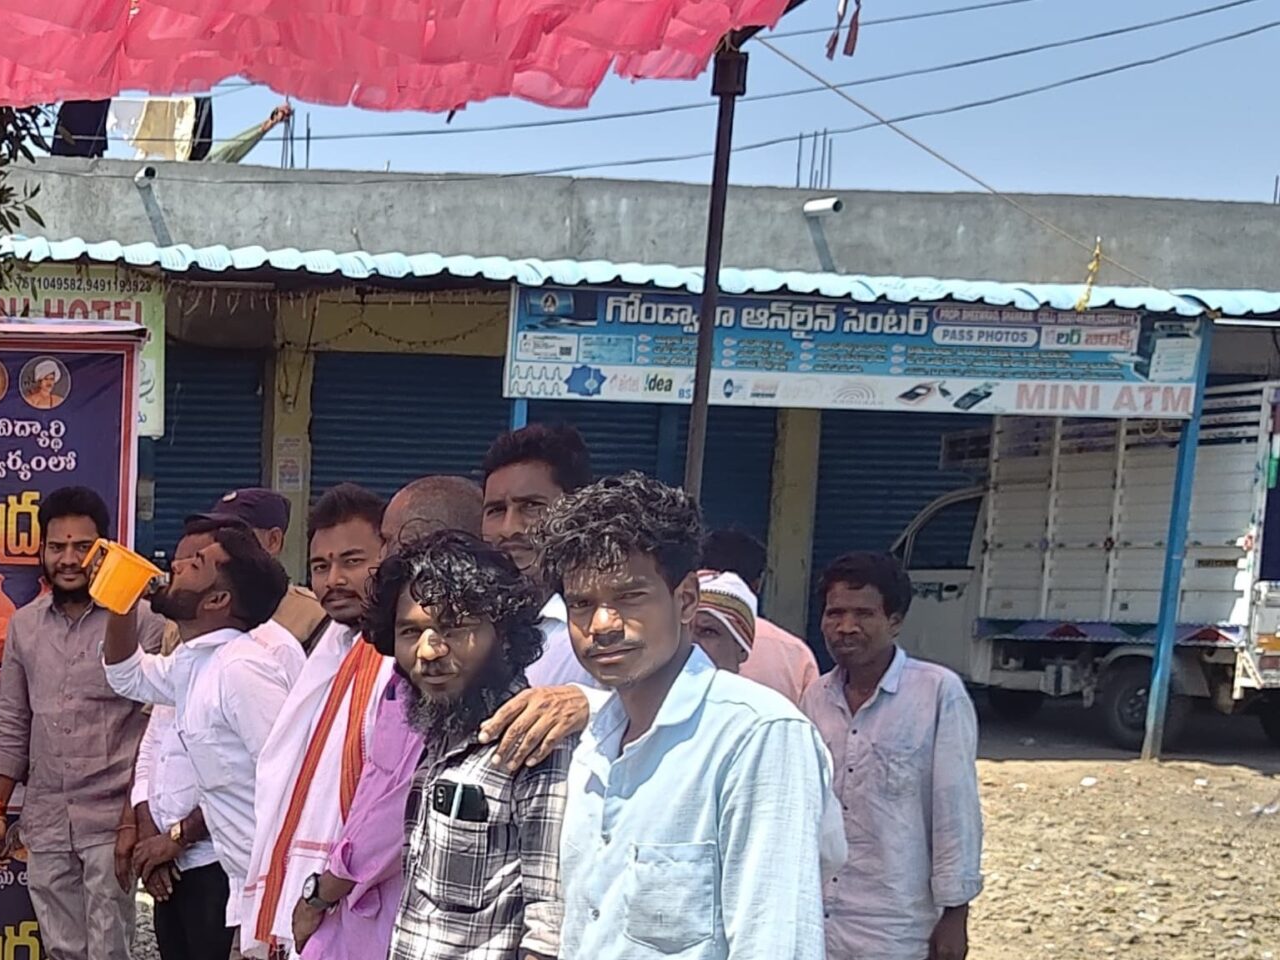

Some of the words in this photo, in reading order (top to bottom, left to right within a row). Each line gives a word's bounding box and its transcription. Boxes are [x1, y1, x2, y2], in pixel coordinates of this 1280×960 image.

[843, 307, 930, 336] సెంటర్
[942, 329, 974, 342] PASS
[977, 330, 1029, 343] PHOTOS
[1015, 383, 1101, 411] MINI
[1111, 385, 1192, 413] ATM
